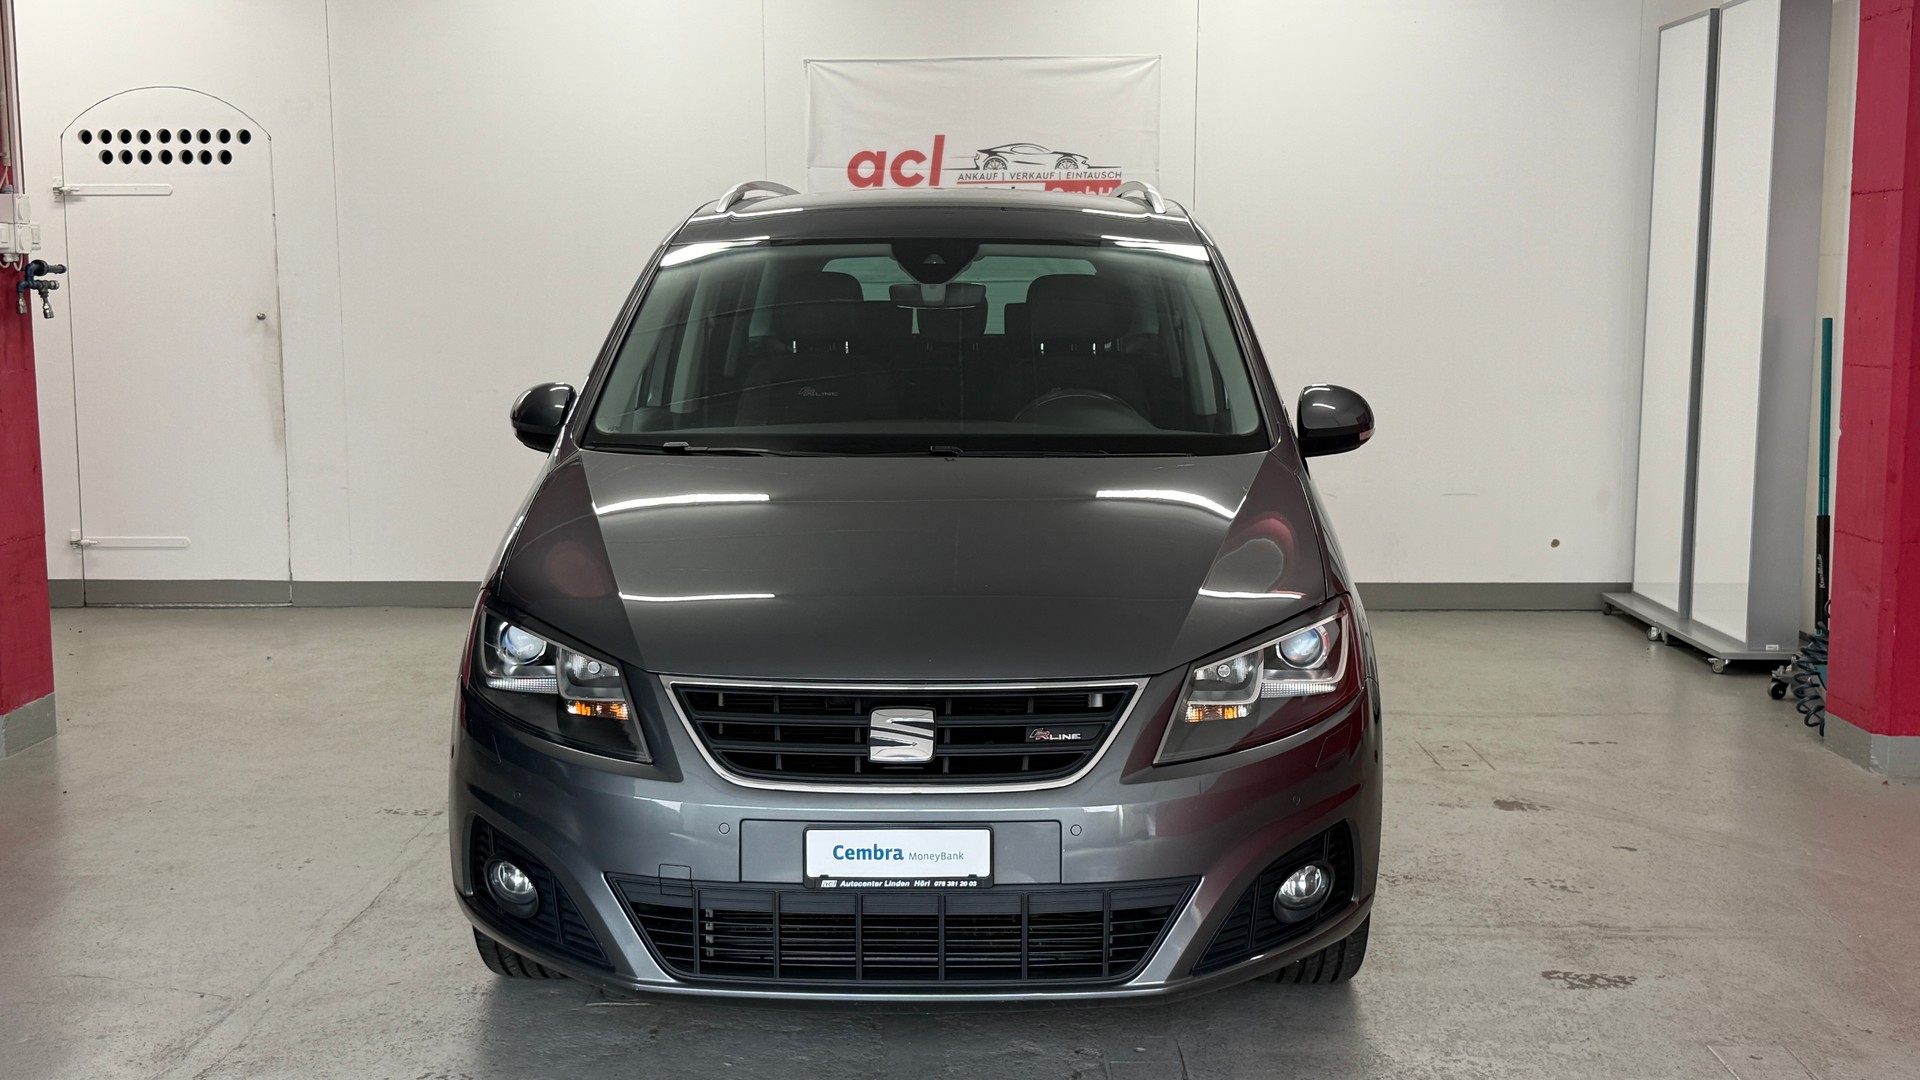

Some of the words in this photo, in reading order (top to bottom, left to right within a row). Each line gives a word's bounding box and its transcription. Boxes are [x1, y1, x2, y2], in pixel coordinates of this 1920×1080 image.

[847, 134, 945, 188] acl
[957, 172, 999, 181] ANKAUF
[1009, 171, 1055, 180] VERKAUF
[1066, 171, 1122, 180] EINTAUSCH
[1051, 186, 1113, 196] bH
[833, 843, 904, 861] Cembra
[908, 851, 964, 863] MoneyBank
[840, 880, 883, 888] Autocenter
[884, 880, 910, 888] Linden
